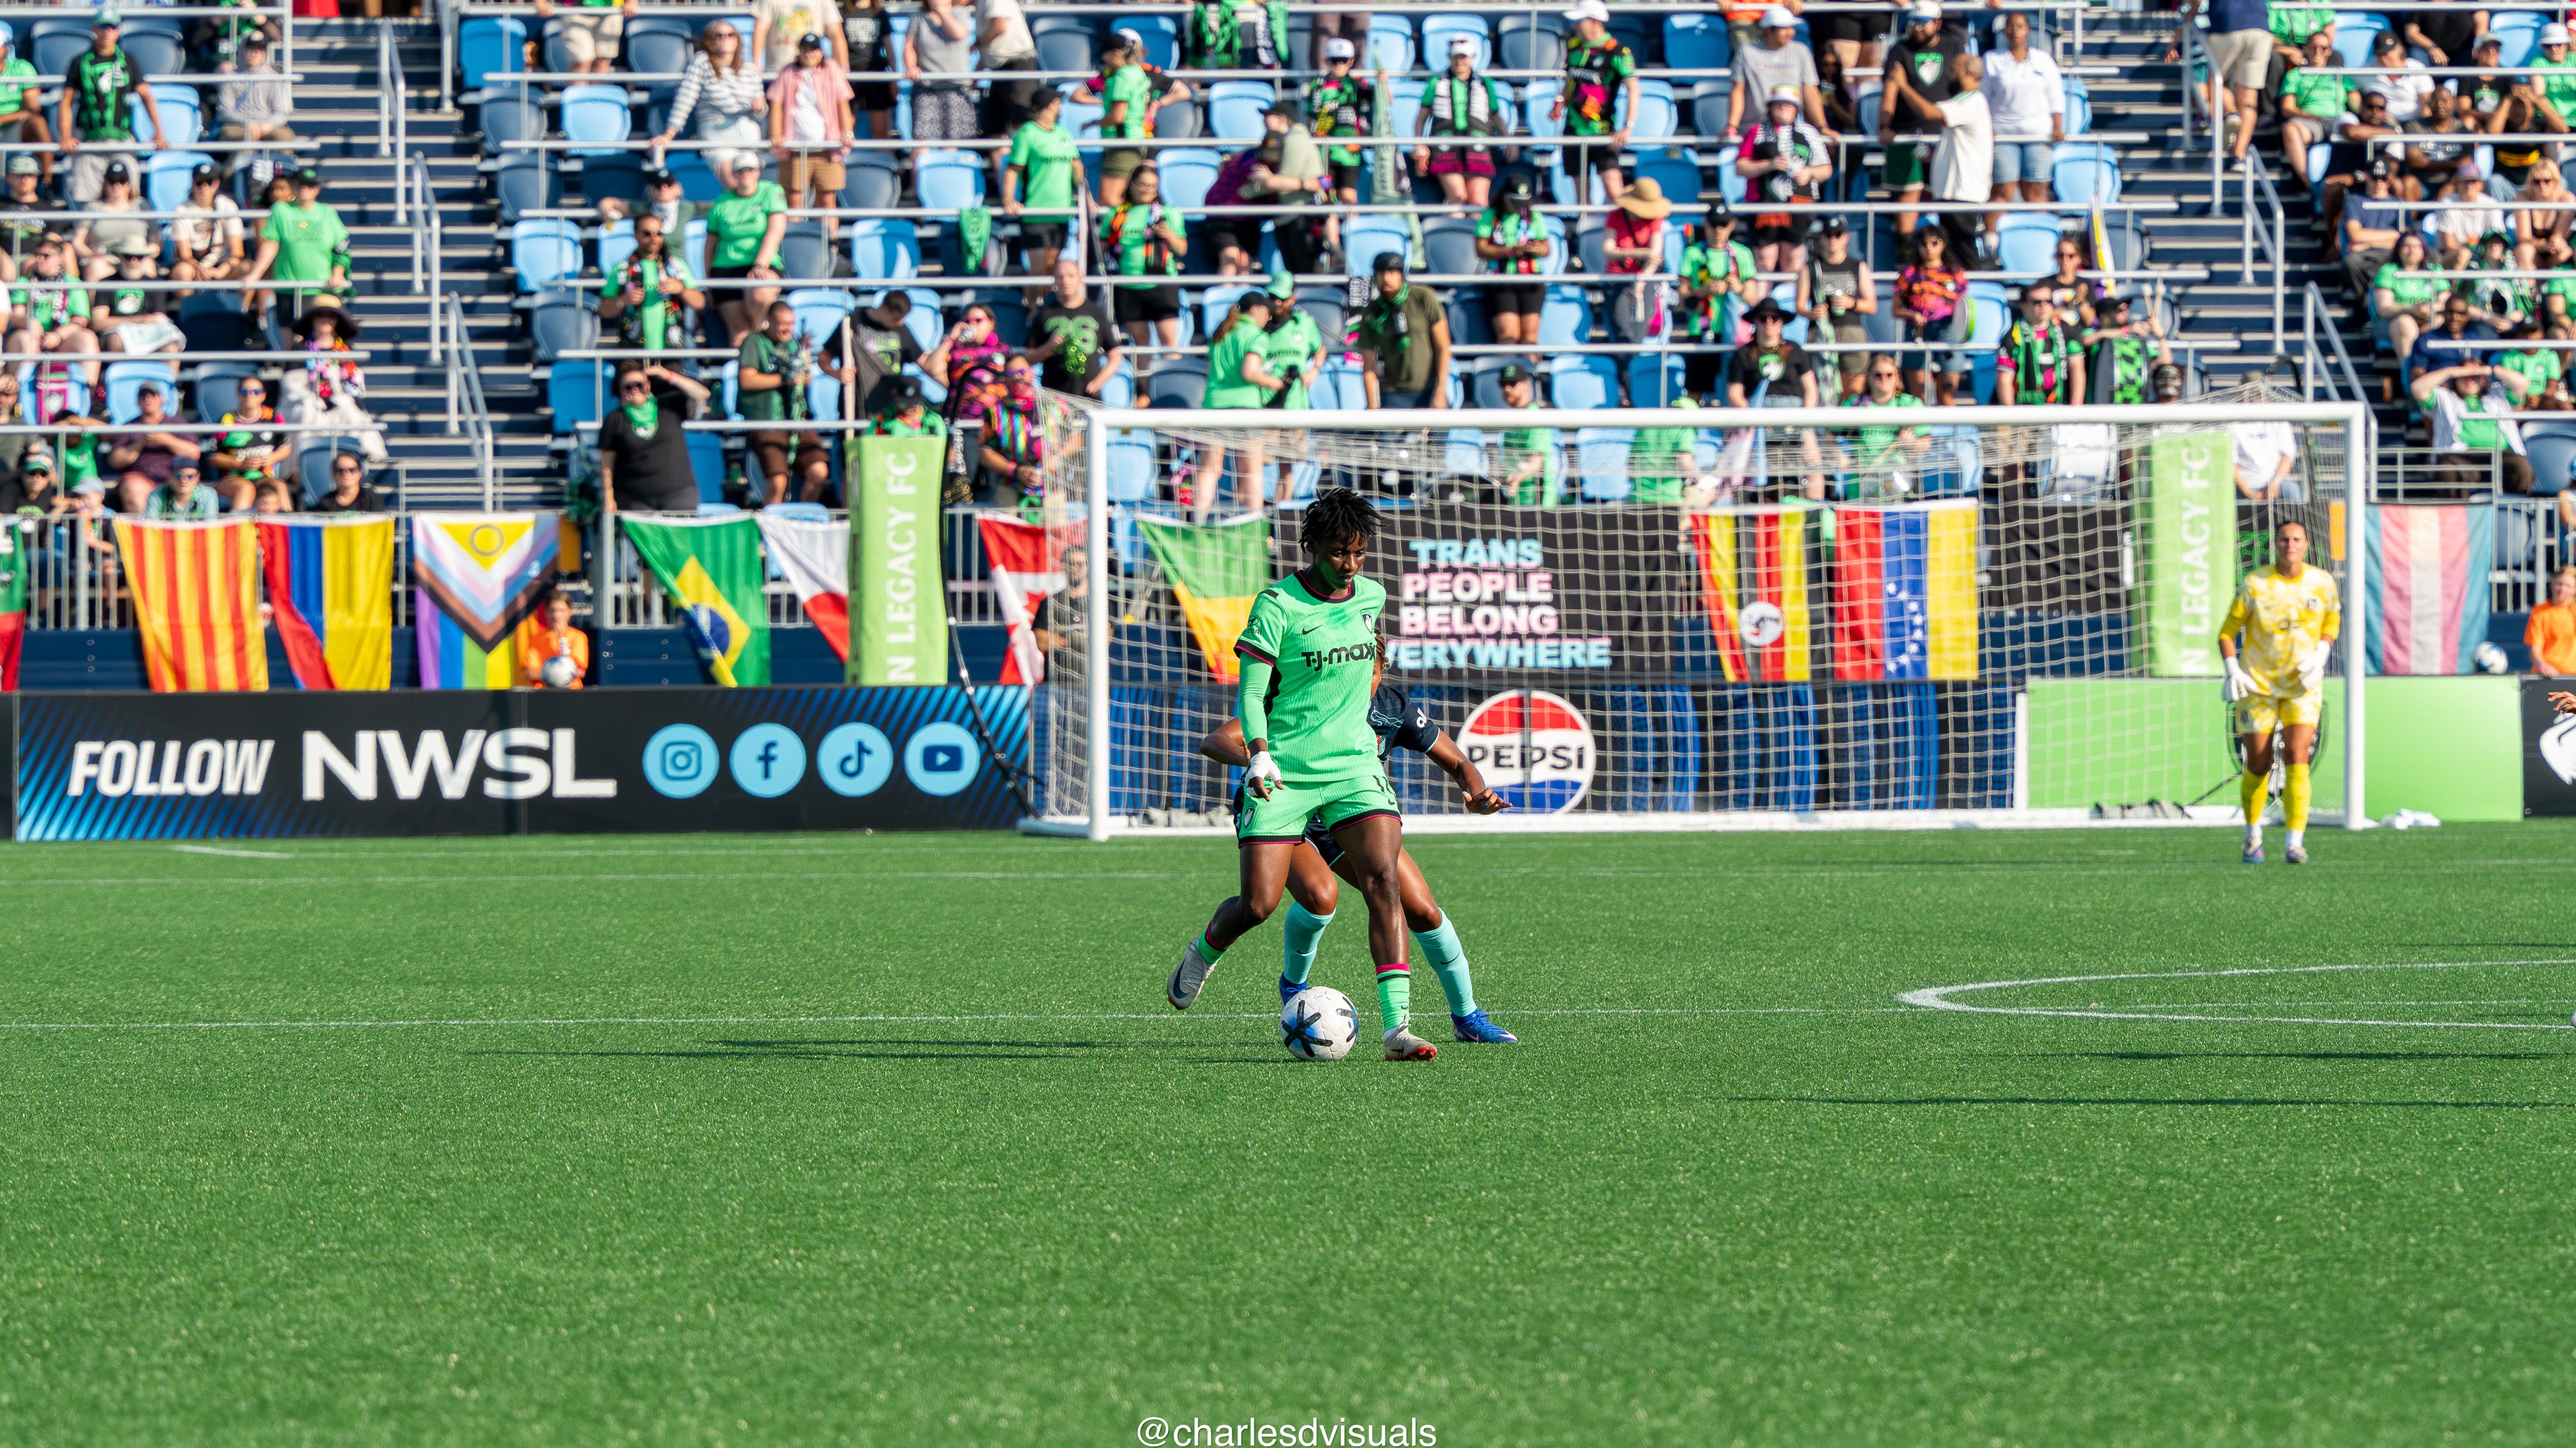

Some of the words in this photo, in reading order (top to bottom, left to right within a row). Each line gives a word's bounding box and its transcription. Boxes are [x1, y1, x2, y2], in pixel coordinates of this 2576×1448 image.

[886, 451, 917, 496] FC
[2182, 446, 2212, 489] FC
[1409, 539, 1543, 569] TRANS
[2182, 499, 2212, 635] LEGACY
[886, 505, 917, 644] LEGACY
[1403, 572, 1554, 603] PEOPLE
[1399, 605, 1559, 635] BELONG
[1385, 637, 1613, 670] VERYWHERE
[67, 739, 274, 796] FOLLOW
[302, 727, 617, 800] NWSL
[1467, 745, 1586, 770] PEPSI
